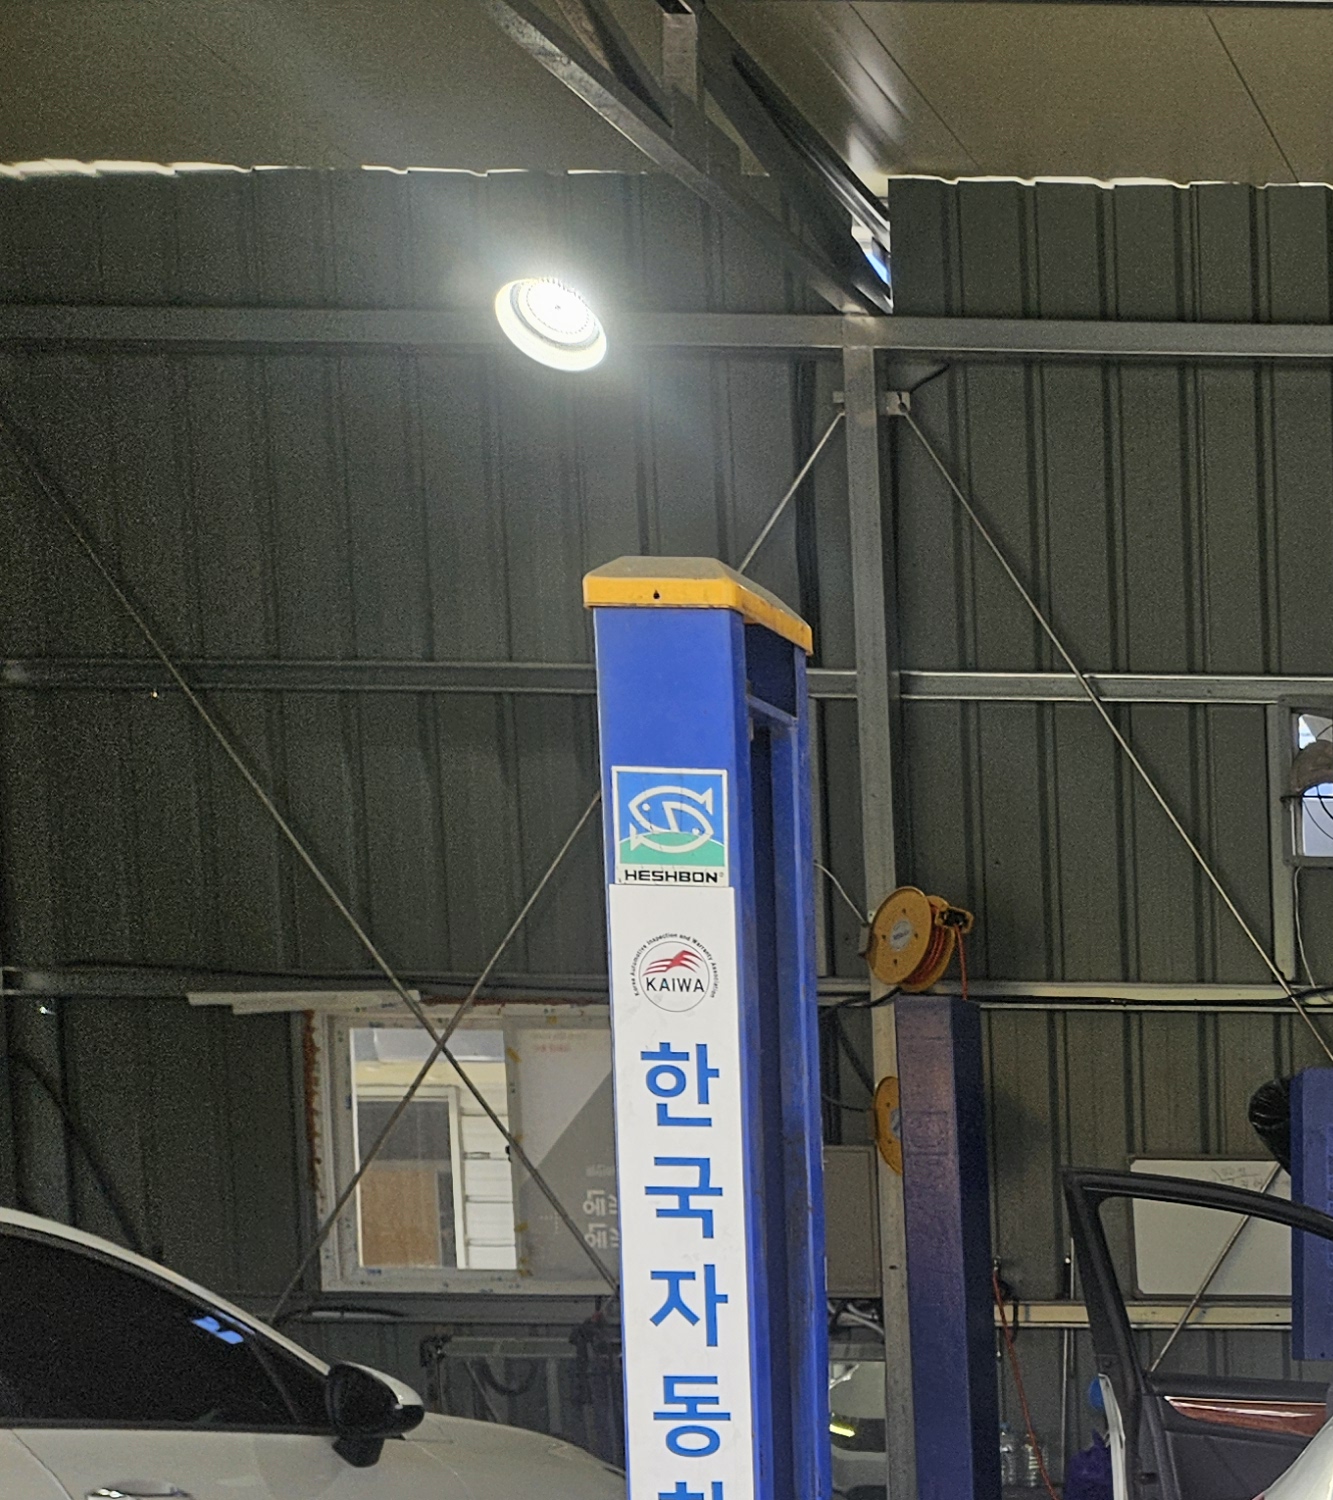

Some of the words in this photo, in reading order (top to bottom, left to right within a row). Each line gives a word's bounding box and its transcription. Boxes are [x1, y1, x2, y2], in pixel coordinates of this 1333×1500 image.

[624, 869, 719, 883] HESHBON
[679, 933, 691, 942] and
[646, 977, 705, 993] KAIWA
